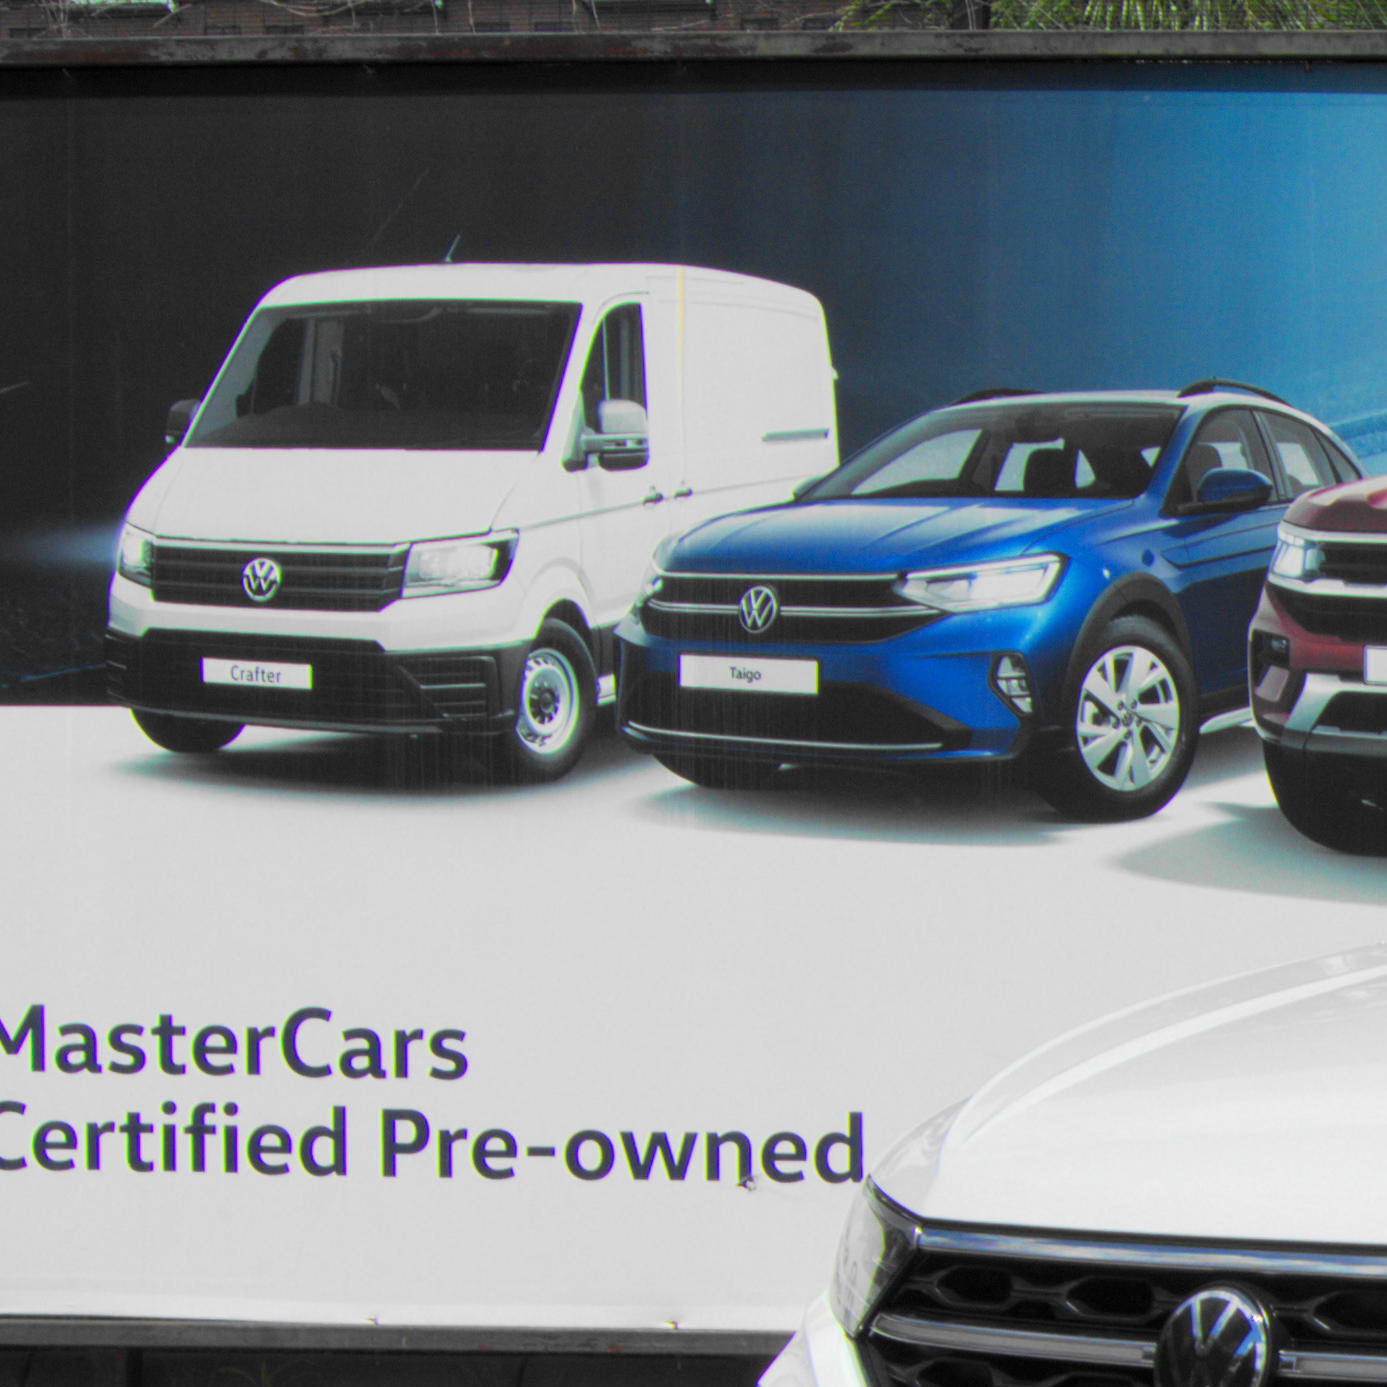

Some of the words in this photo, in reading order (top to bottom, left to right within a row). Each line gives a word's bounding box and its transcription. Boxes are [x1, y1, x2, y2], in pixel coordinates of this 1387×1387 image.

[230, 664, 281, 683] Crafter
[730, 666, 762, 683] Taigo
[0, 1004, 468, 1080] MasterCars
[381, 1108, 864, 1182] Pre-owned
